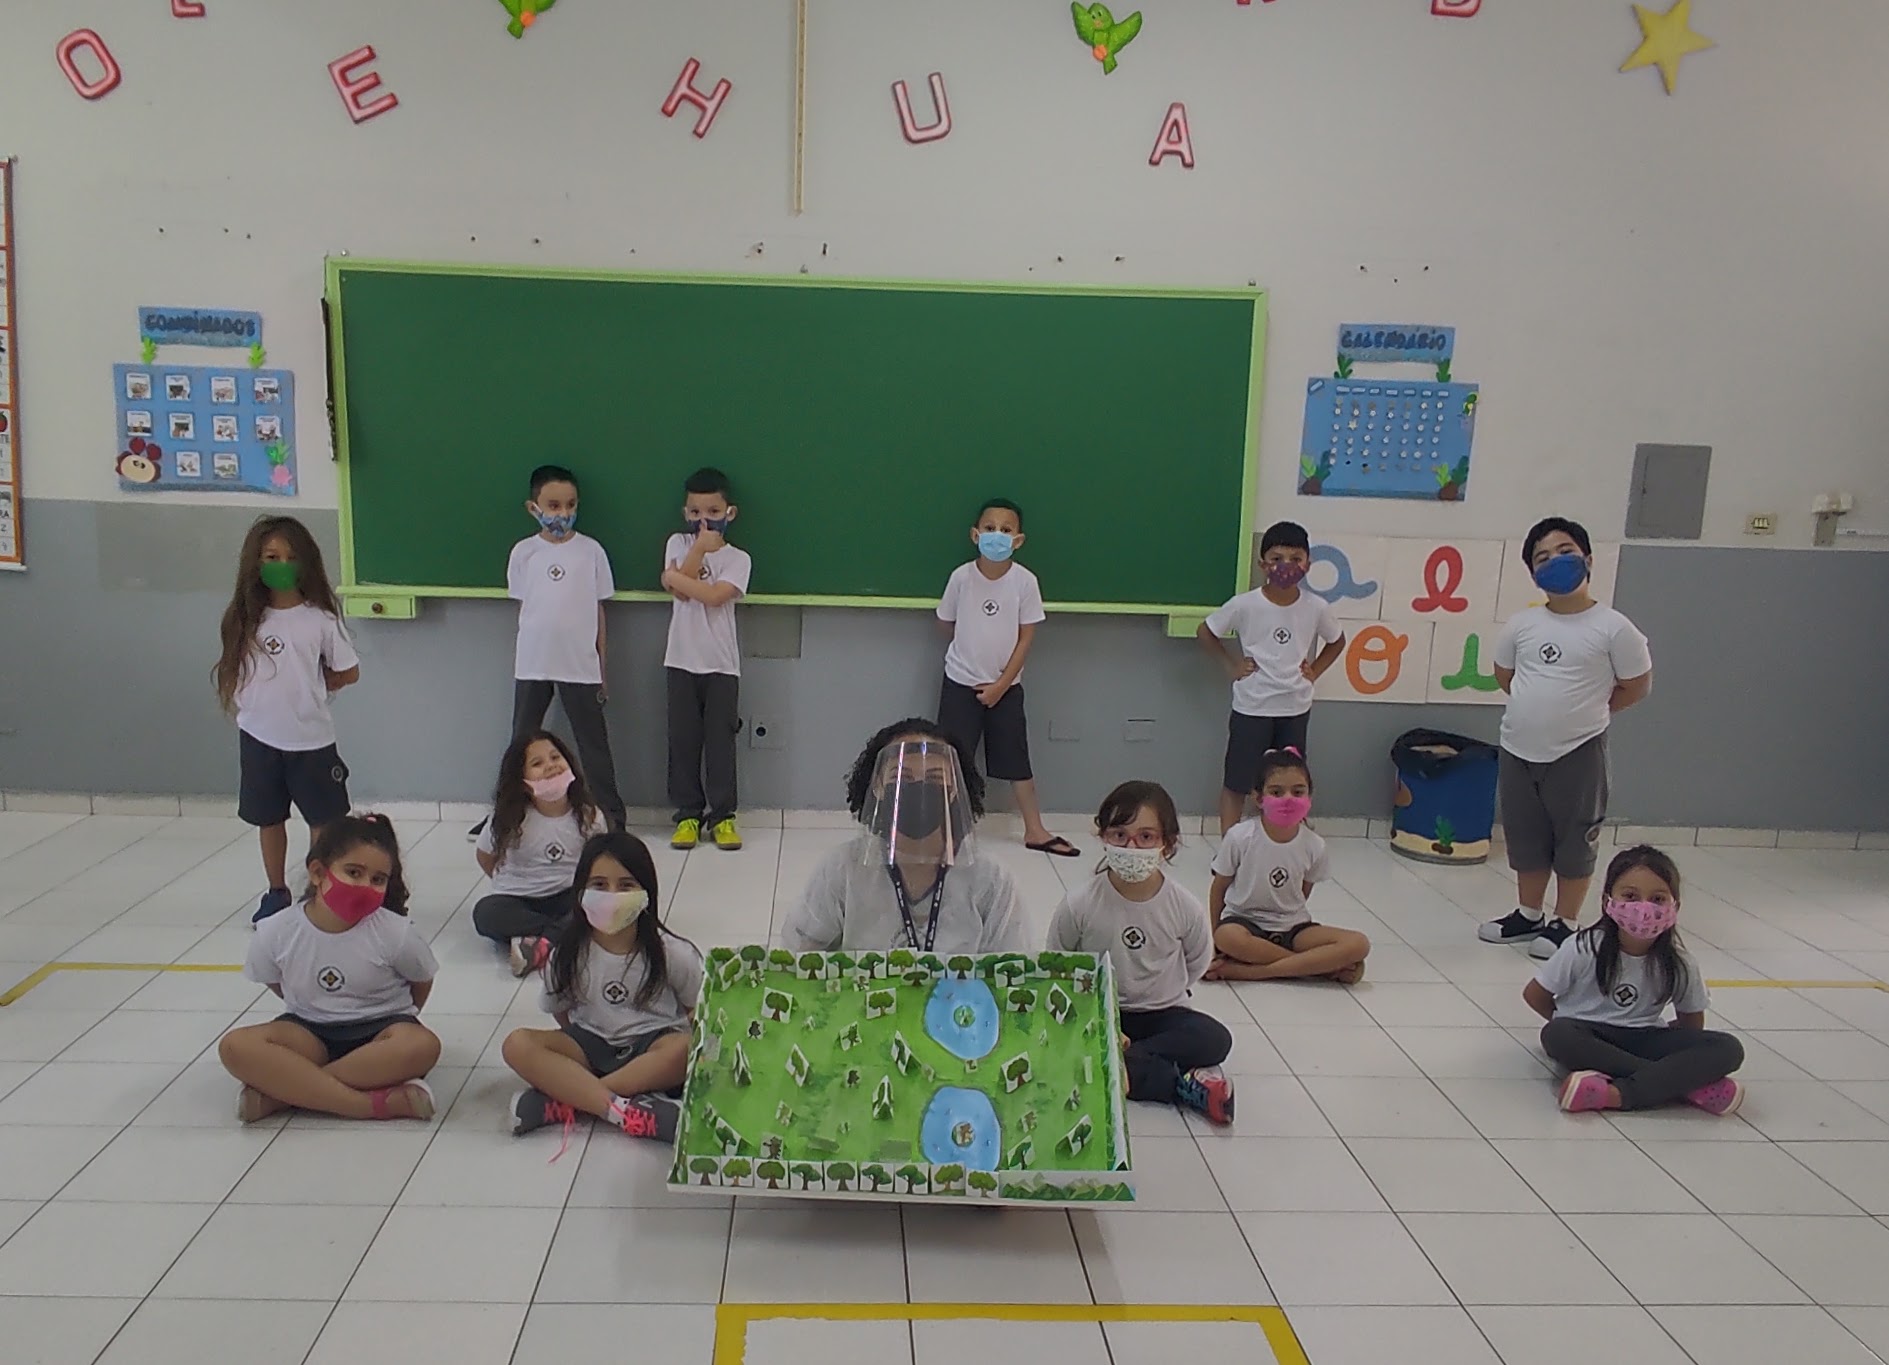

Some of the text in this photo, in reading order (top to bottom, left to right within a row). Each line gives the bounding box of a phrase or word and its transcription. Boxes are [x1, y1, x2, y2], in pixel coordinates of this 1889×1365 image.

[328, 45, 399, 125] E
[661, 57, 732, 139] H
[892, 72, 952, 144] U
[1148, 102, 1195, 168] A
